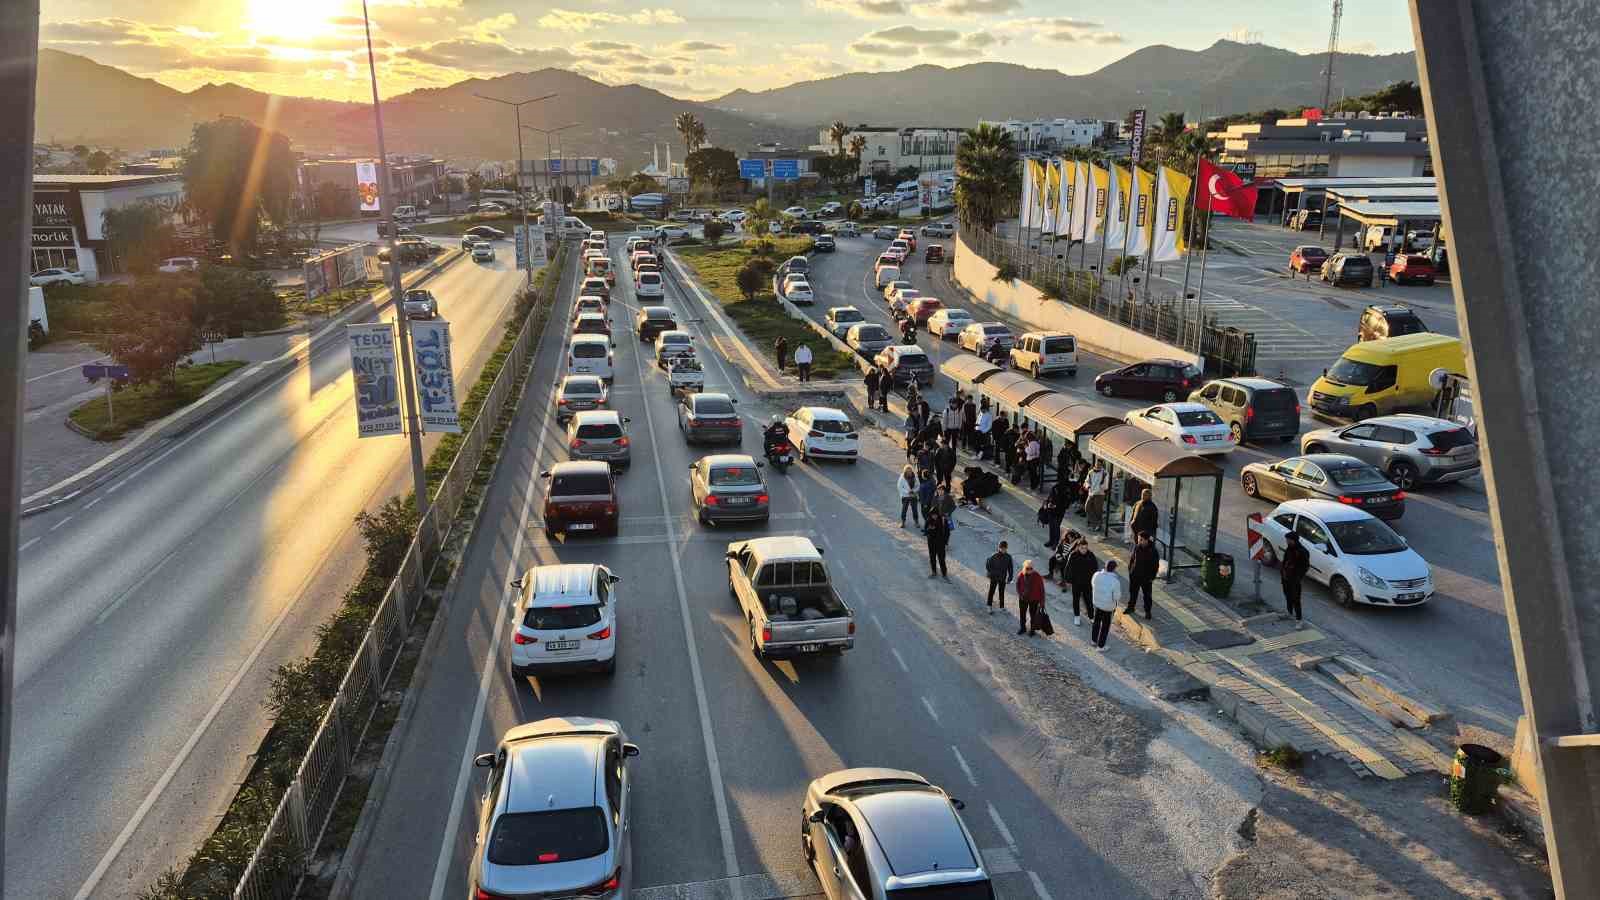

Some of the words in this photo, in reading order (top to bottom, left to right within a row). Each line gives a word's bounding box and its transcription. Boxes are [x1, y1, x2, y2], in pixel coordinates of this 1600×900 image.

[1132, 111, 1144, 162] EMORIAL
[35, 204, 66, 215] YATAK
[1137, 194, 1147, 226] METRO
[1168, 198, 1177, 231] METRO
[351, 334, 391, 346] TEOL
[416, 328, 445, 412] TEOL
